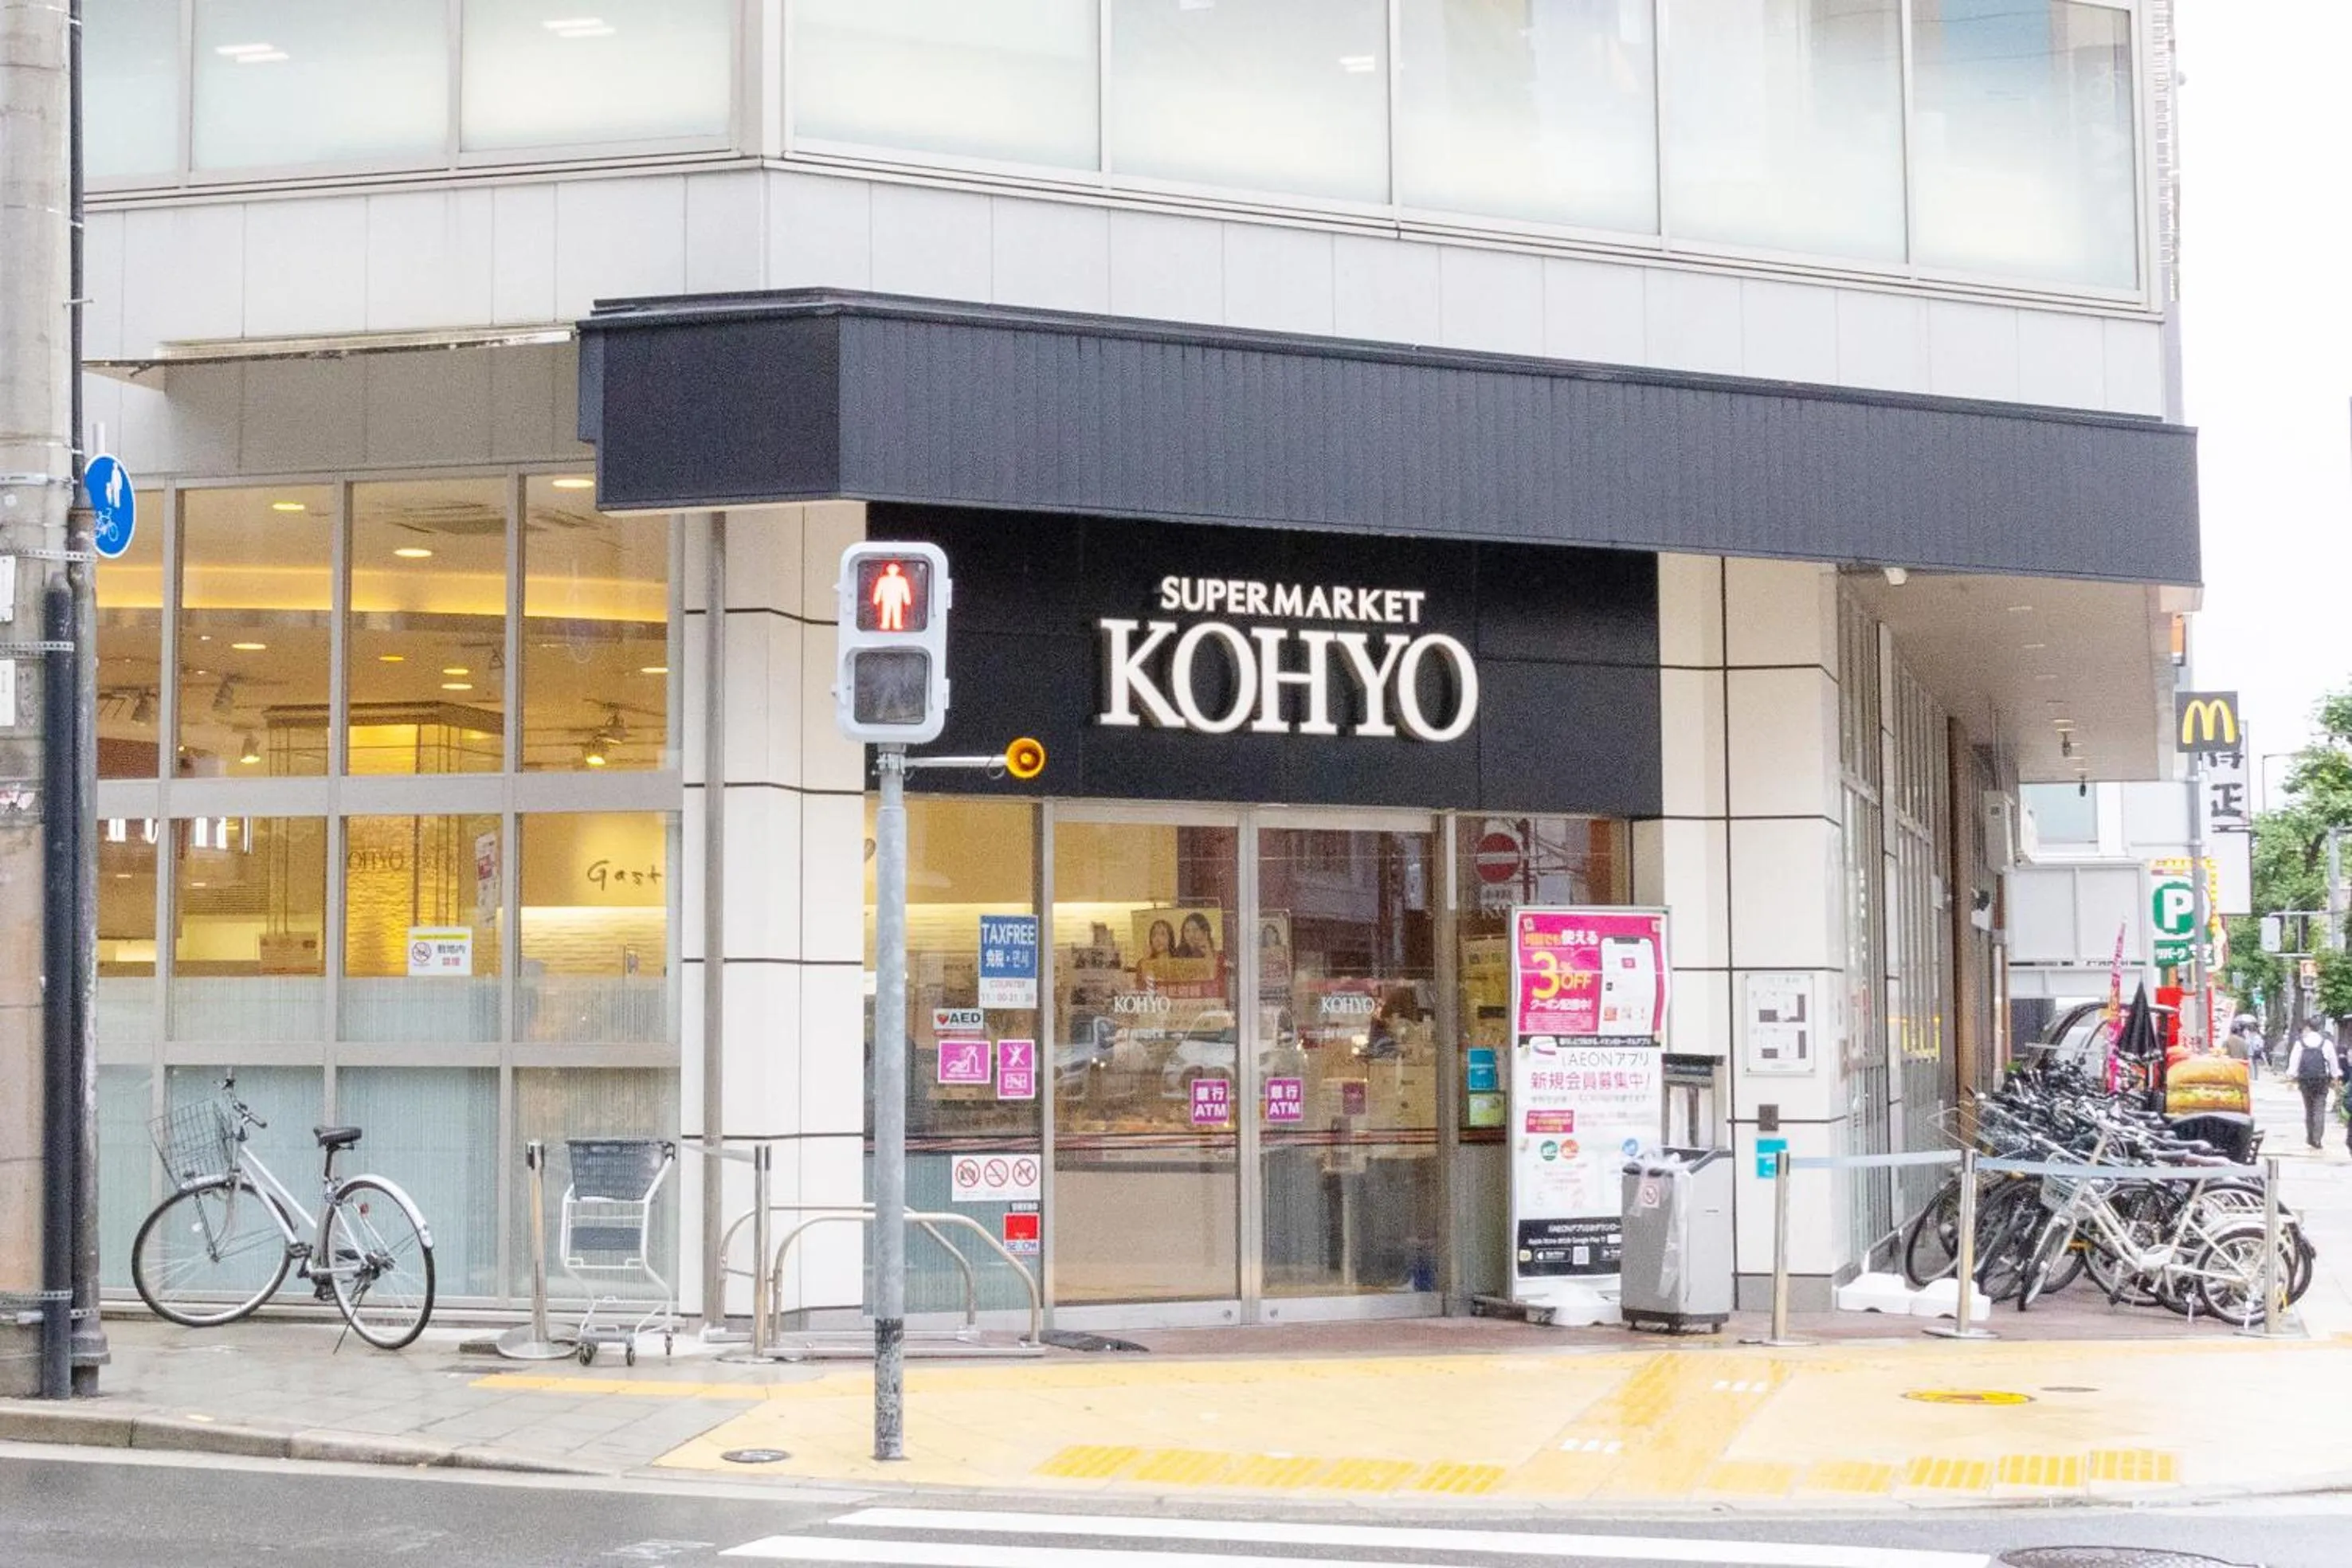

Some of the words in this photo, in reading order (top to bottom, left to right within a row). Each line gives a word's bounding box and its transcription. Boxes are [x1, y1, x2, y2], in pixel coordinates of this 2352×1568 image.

[1160, 575, 1425, 623] SUPERMARKET
[1100, 618, 1478, 743] KOHYO
[2163, 888, 2194, 929] P
[981, 924, 1035, 945] TAXFREE
[1531, 951, 1560, 999] 3
[1561, 973, 1591, 990] OFF
[1114, 996, 1170, 1013] KOHYO
[1321, 997, 1375, 1014] KOHYO
[950, 1013, 981, 1024] AED
[1195, 1103, 1226, 1117] ATM
[1269, 1102, 1300, 1115] ATM
